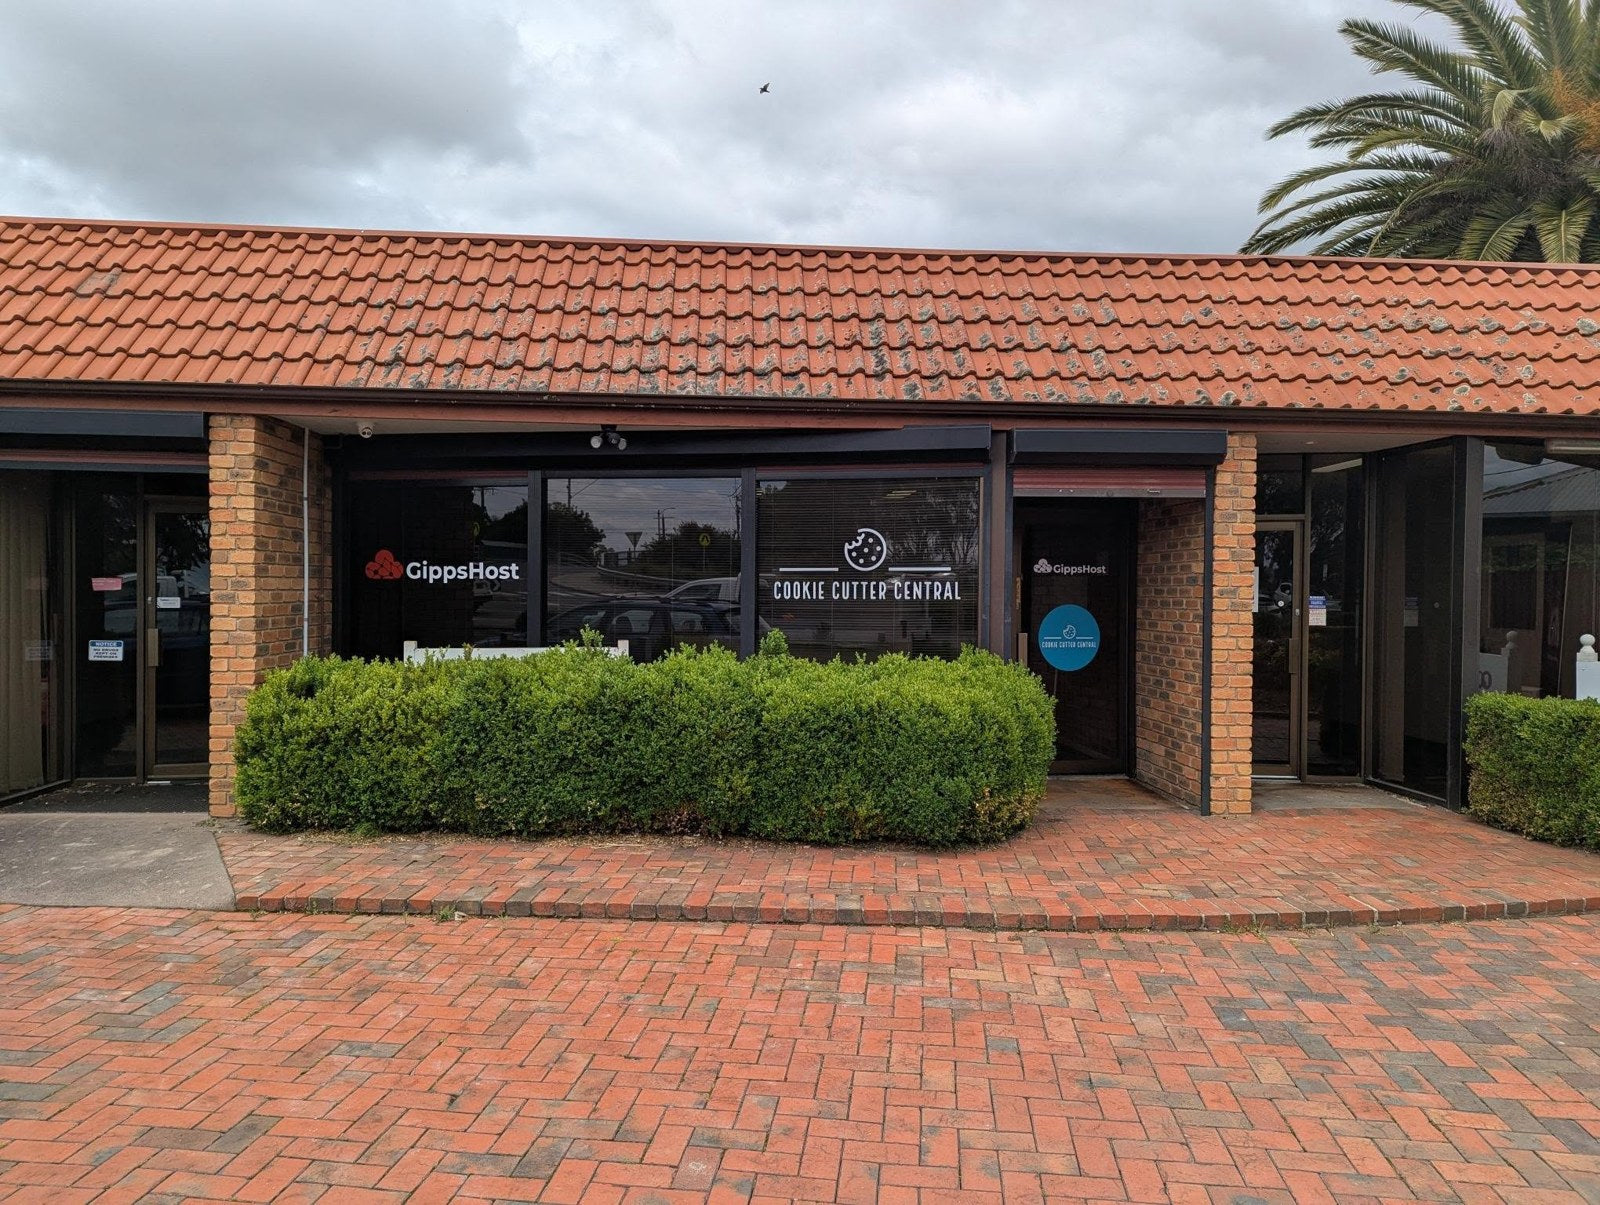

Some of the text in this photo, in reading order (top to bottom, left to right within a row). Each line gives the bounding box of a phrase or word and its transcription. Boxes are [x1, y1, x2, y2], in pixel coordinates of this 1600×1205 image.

[406, 560, 520, 584] GippsHost
[1053, 564, 1106, 575] GippsHost
[773, 580, 962, 600] COOKIE CUTTER CENTRAL
